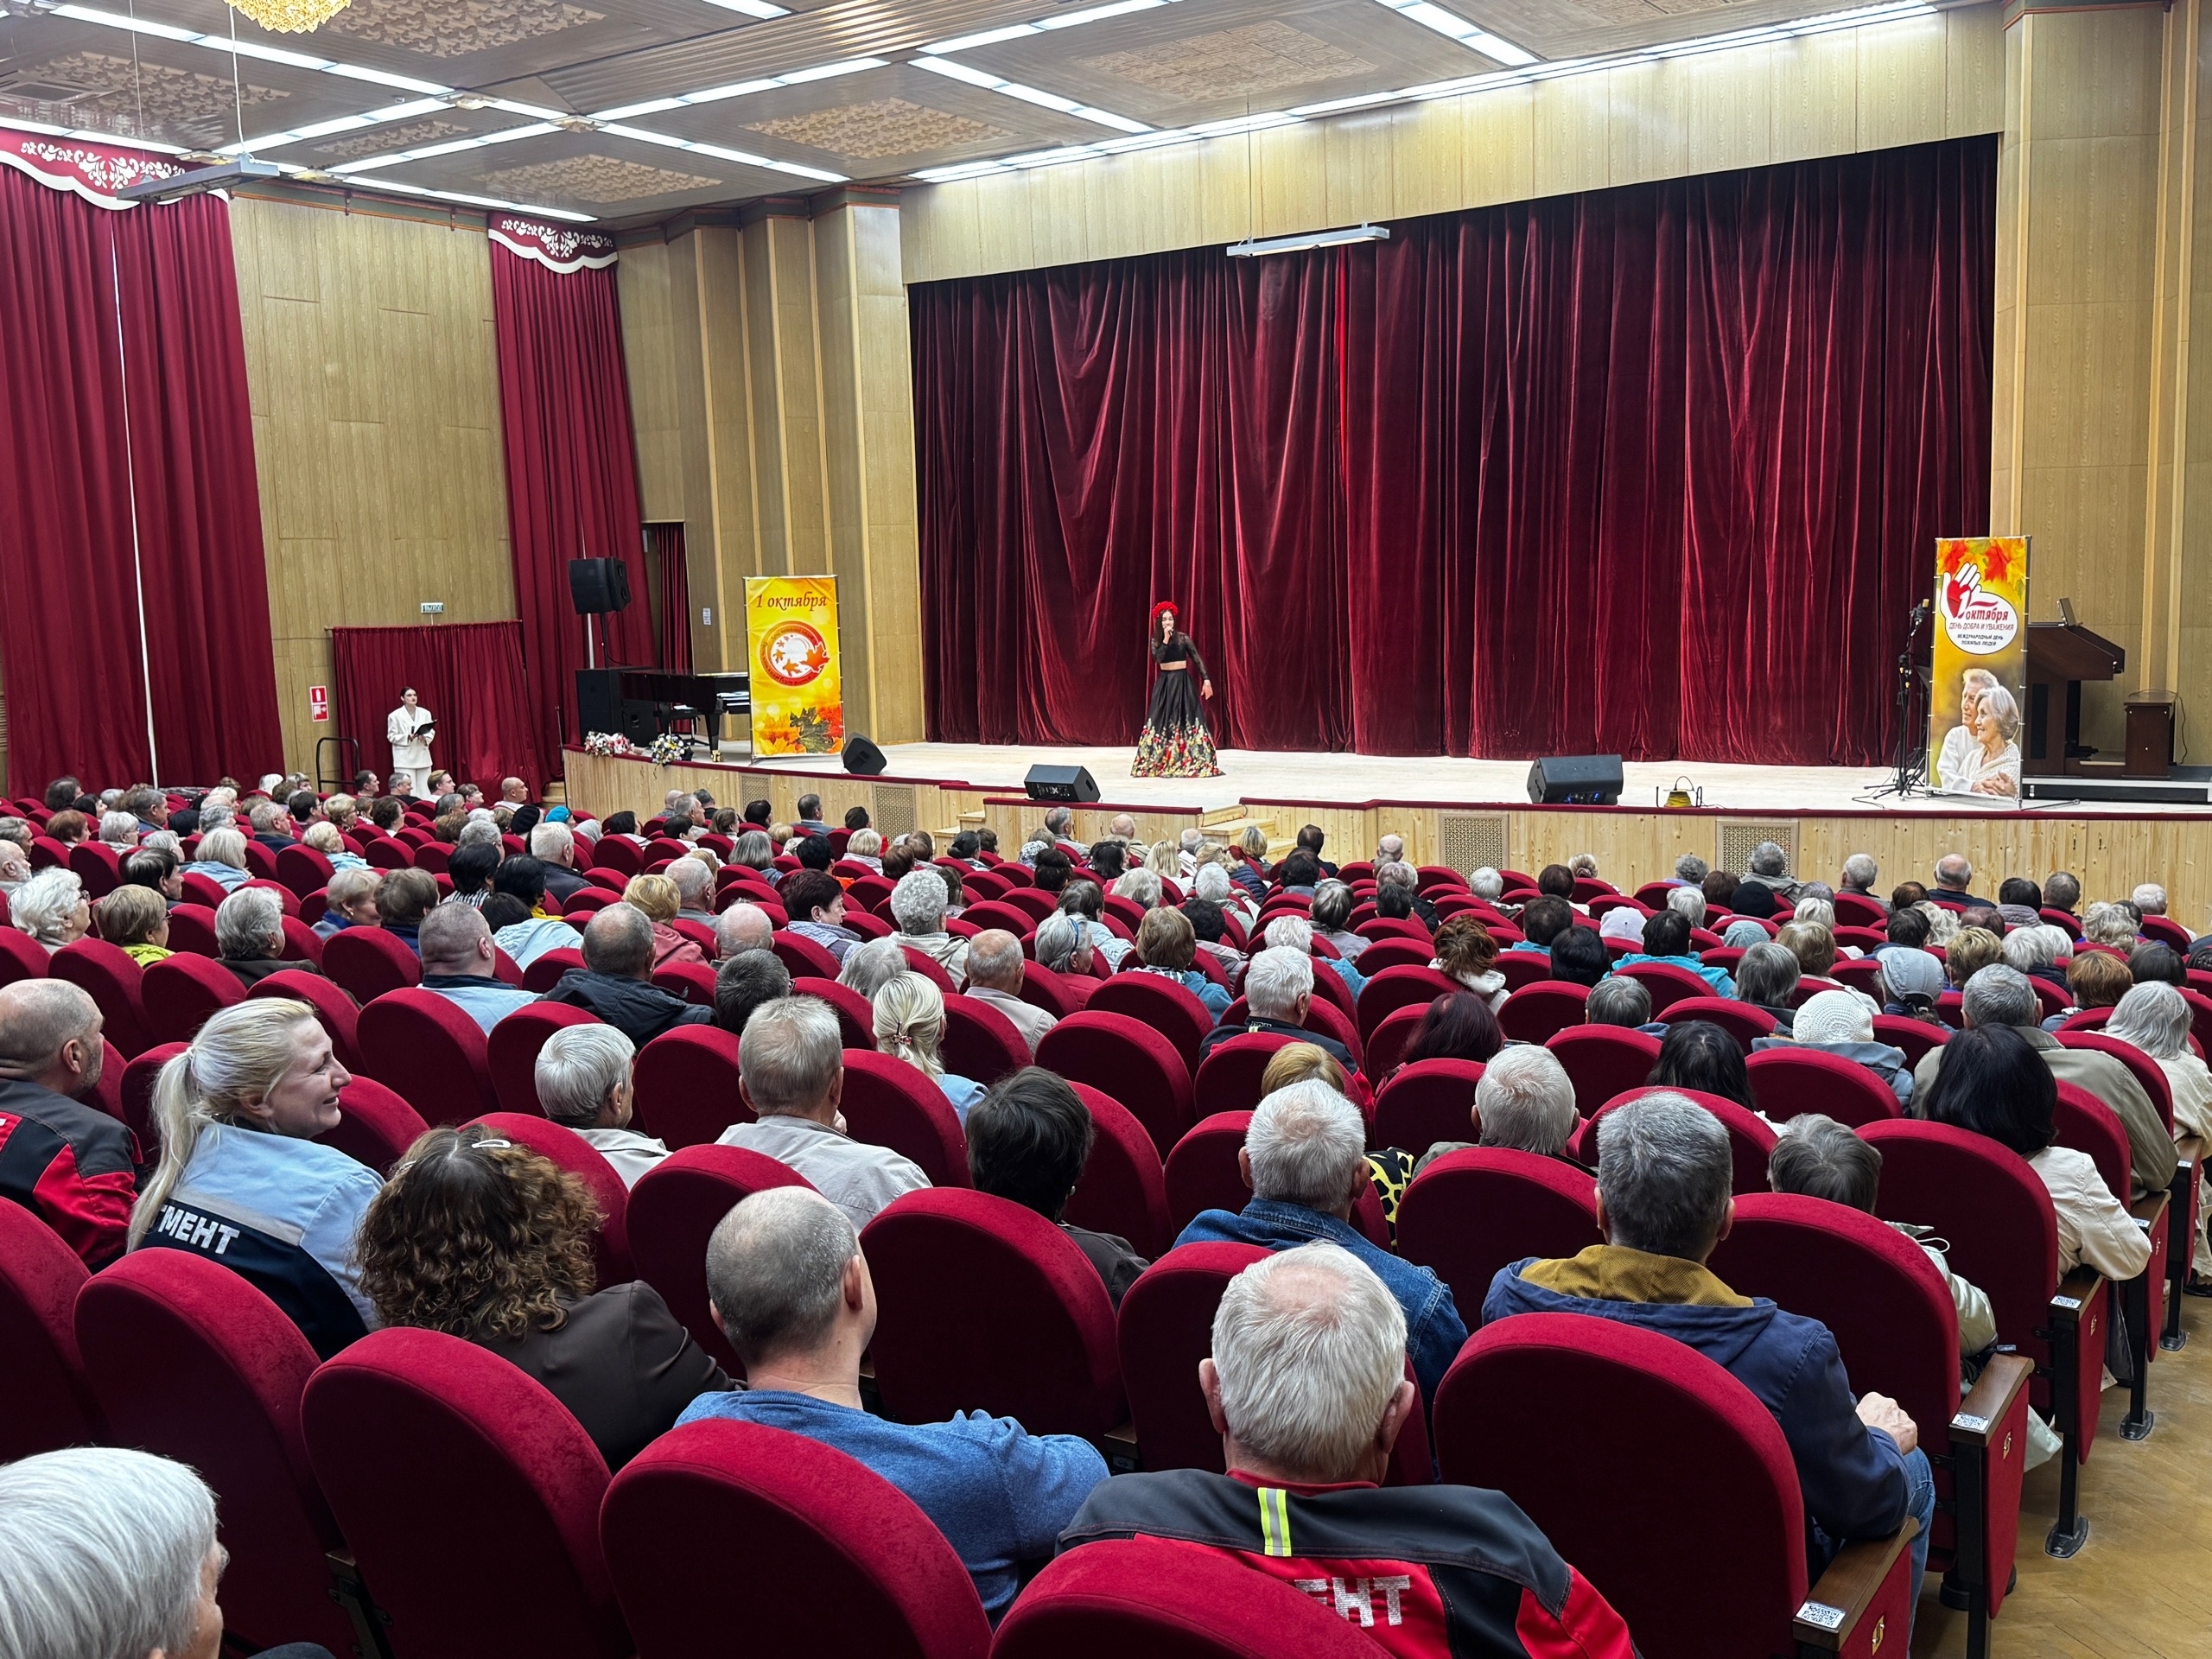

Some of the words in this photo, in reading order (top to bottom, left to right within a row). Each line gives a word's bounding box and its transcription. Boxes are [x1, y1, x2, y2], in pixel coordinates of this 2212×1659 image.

[756, 594, 762, 607] 1
[767, 591, 828, 612] октября
[1966, 607, 2009, 623] октября
[158, 1204, 240, 1255] МЕНТ
